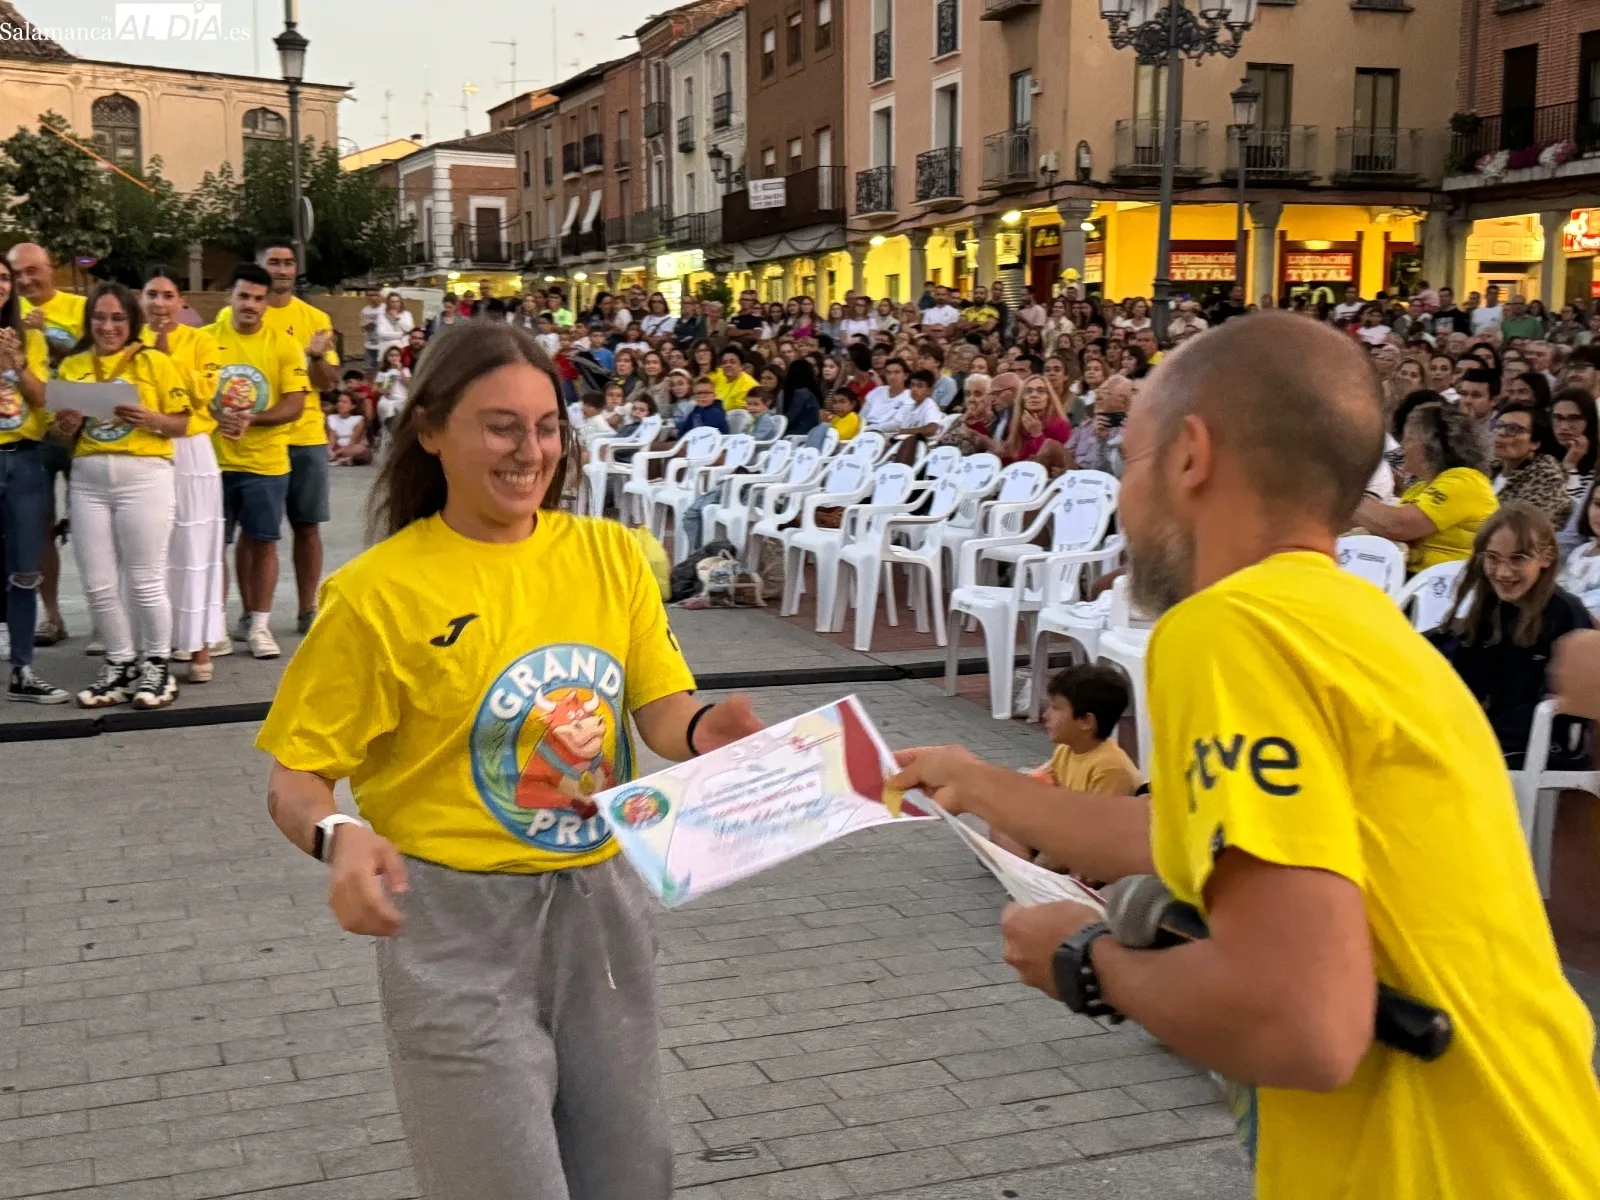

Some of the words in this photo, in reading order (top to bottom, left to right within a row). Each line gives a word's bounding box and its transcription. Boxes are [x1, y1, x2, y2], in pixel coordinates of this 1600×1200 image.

[1170, 268, 1236, 280] TOTAL
[1287, 269, 1352, 281] TOTAL
[489, 648, 622, 720] GRAND
[1185, 733, 1302, 814] rtve
[526, 807, 614, 846] PRI
